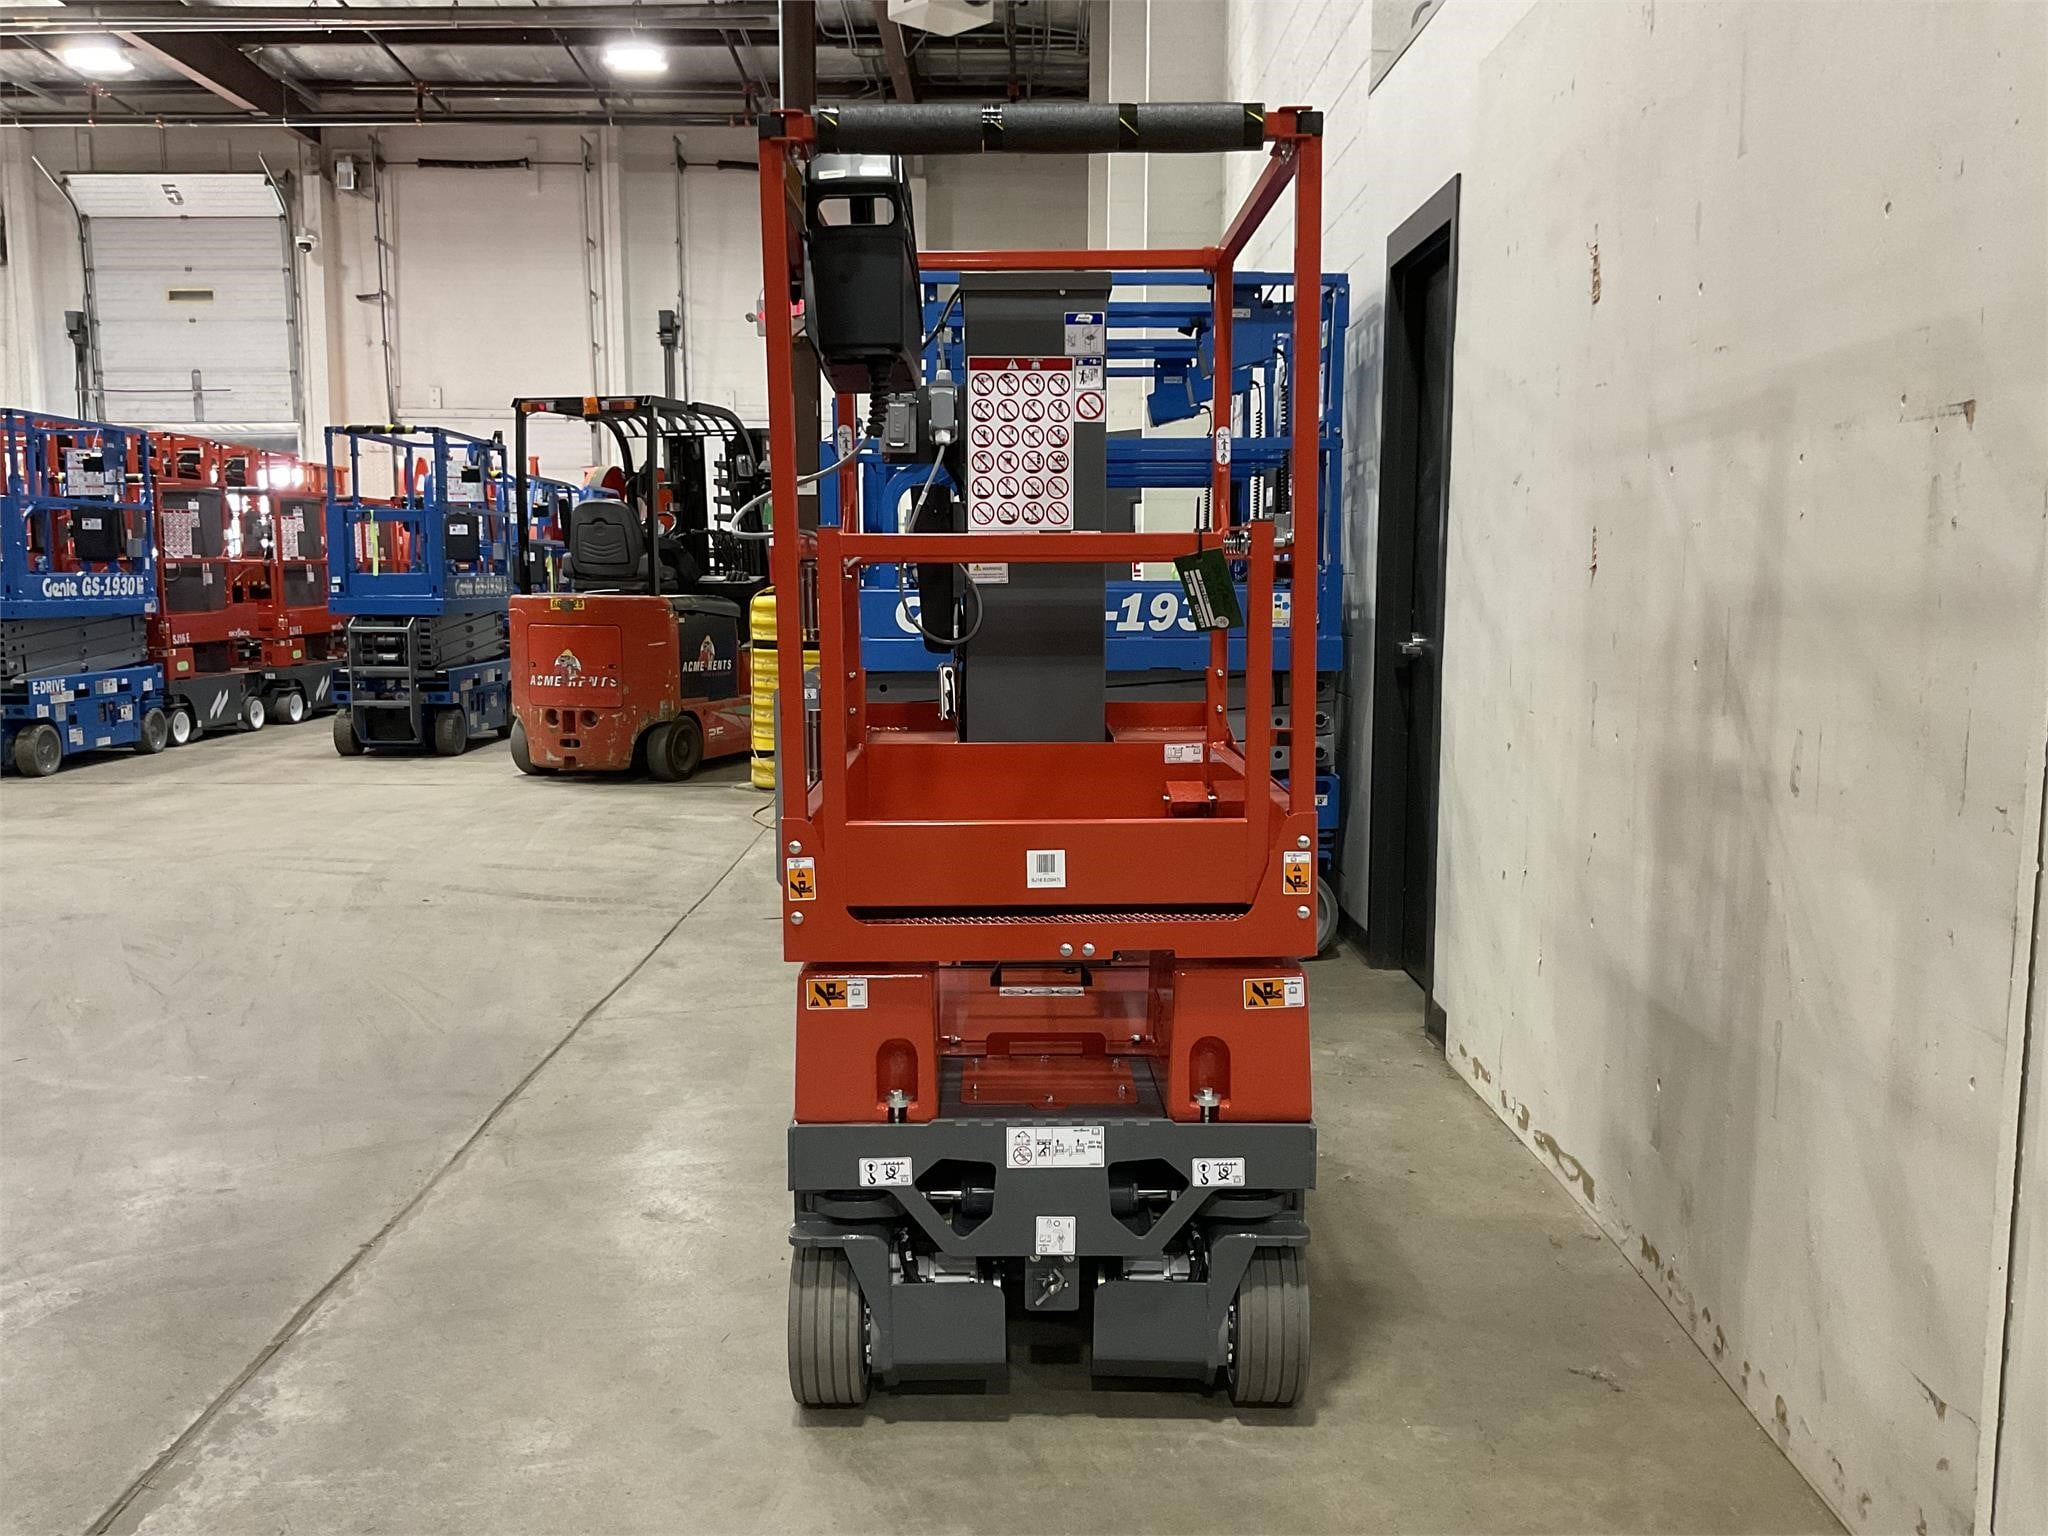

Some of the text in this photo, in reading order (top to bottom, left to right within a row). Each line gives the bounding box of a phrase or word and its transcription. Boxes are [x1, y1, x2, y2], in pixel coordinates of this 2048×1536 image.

[161, 184, 184, 205] 5
[42, 577, 78, 597] Genie
[82, 576, 135, 596] GS-1930
[682, 660, 705, 673] ACME
[32, 679, 66, 695] E-DRIVE
[530, 674, 562, 688] ACME
